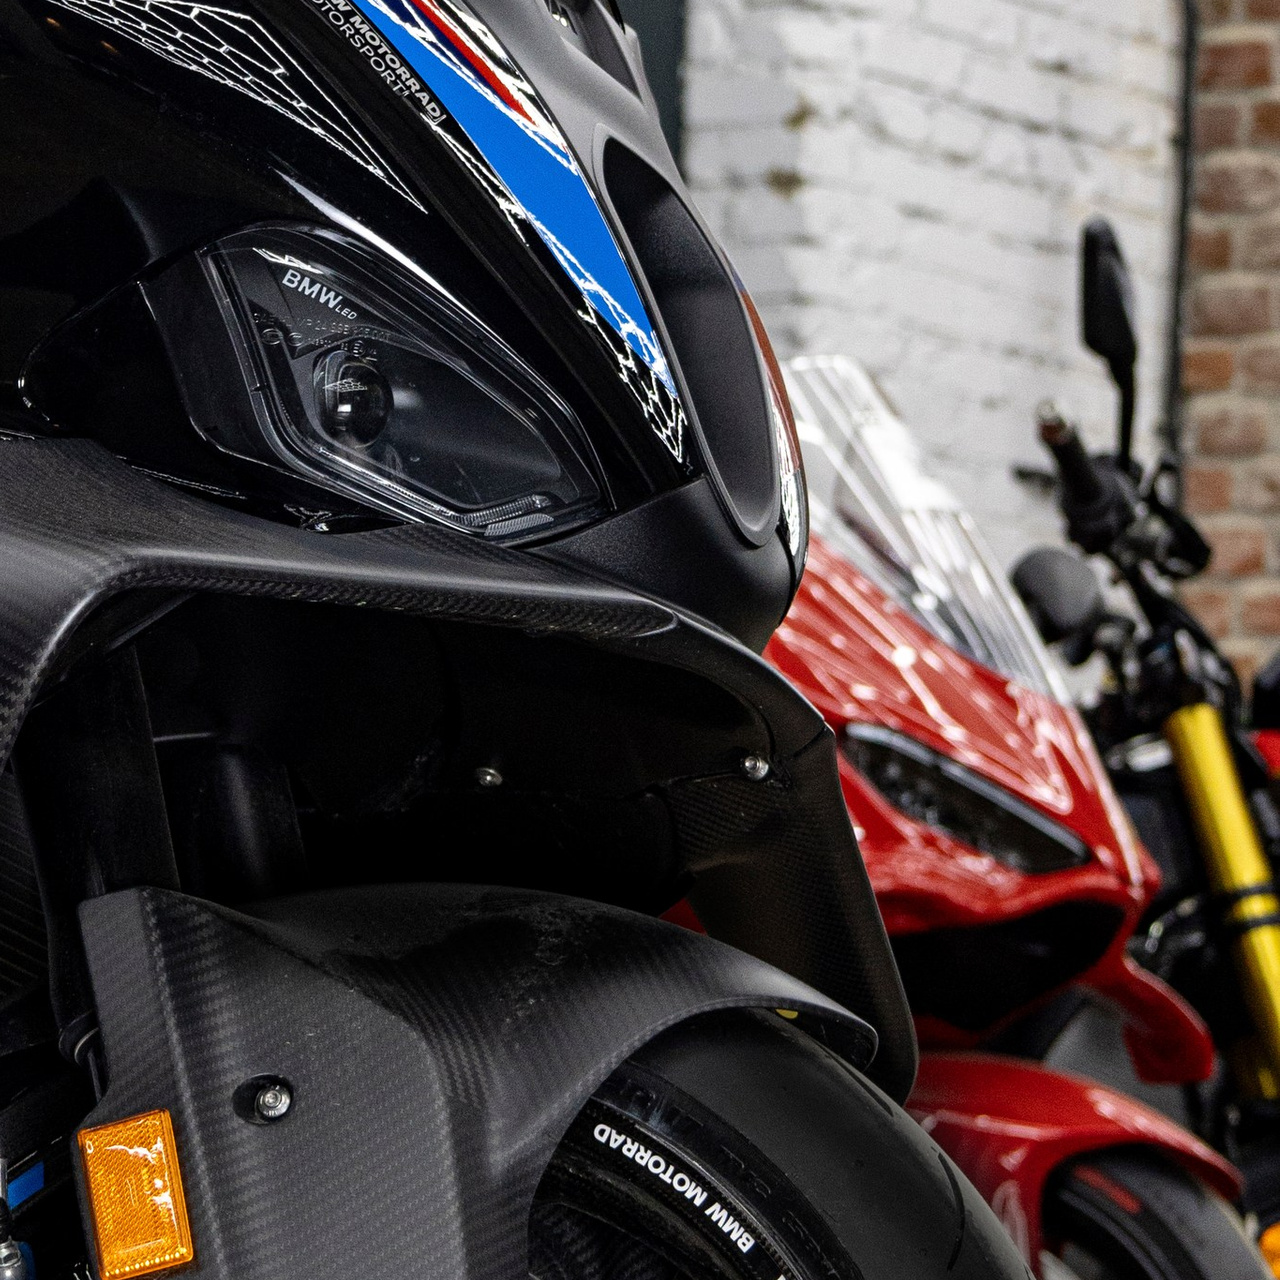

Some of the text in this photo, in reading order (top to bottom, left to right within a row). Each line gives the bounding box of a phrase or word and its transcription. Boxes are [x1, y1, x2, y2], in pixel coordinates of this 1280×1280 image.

[349, 15, 441, 119] MOTORRAD
[282, 269, 344, 309] BMW
[335, 304, 357, 320] LED
[593, 1123, 708, 1207] MOTORRAD
[705, 1202, 755, 1253] BMW
